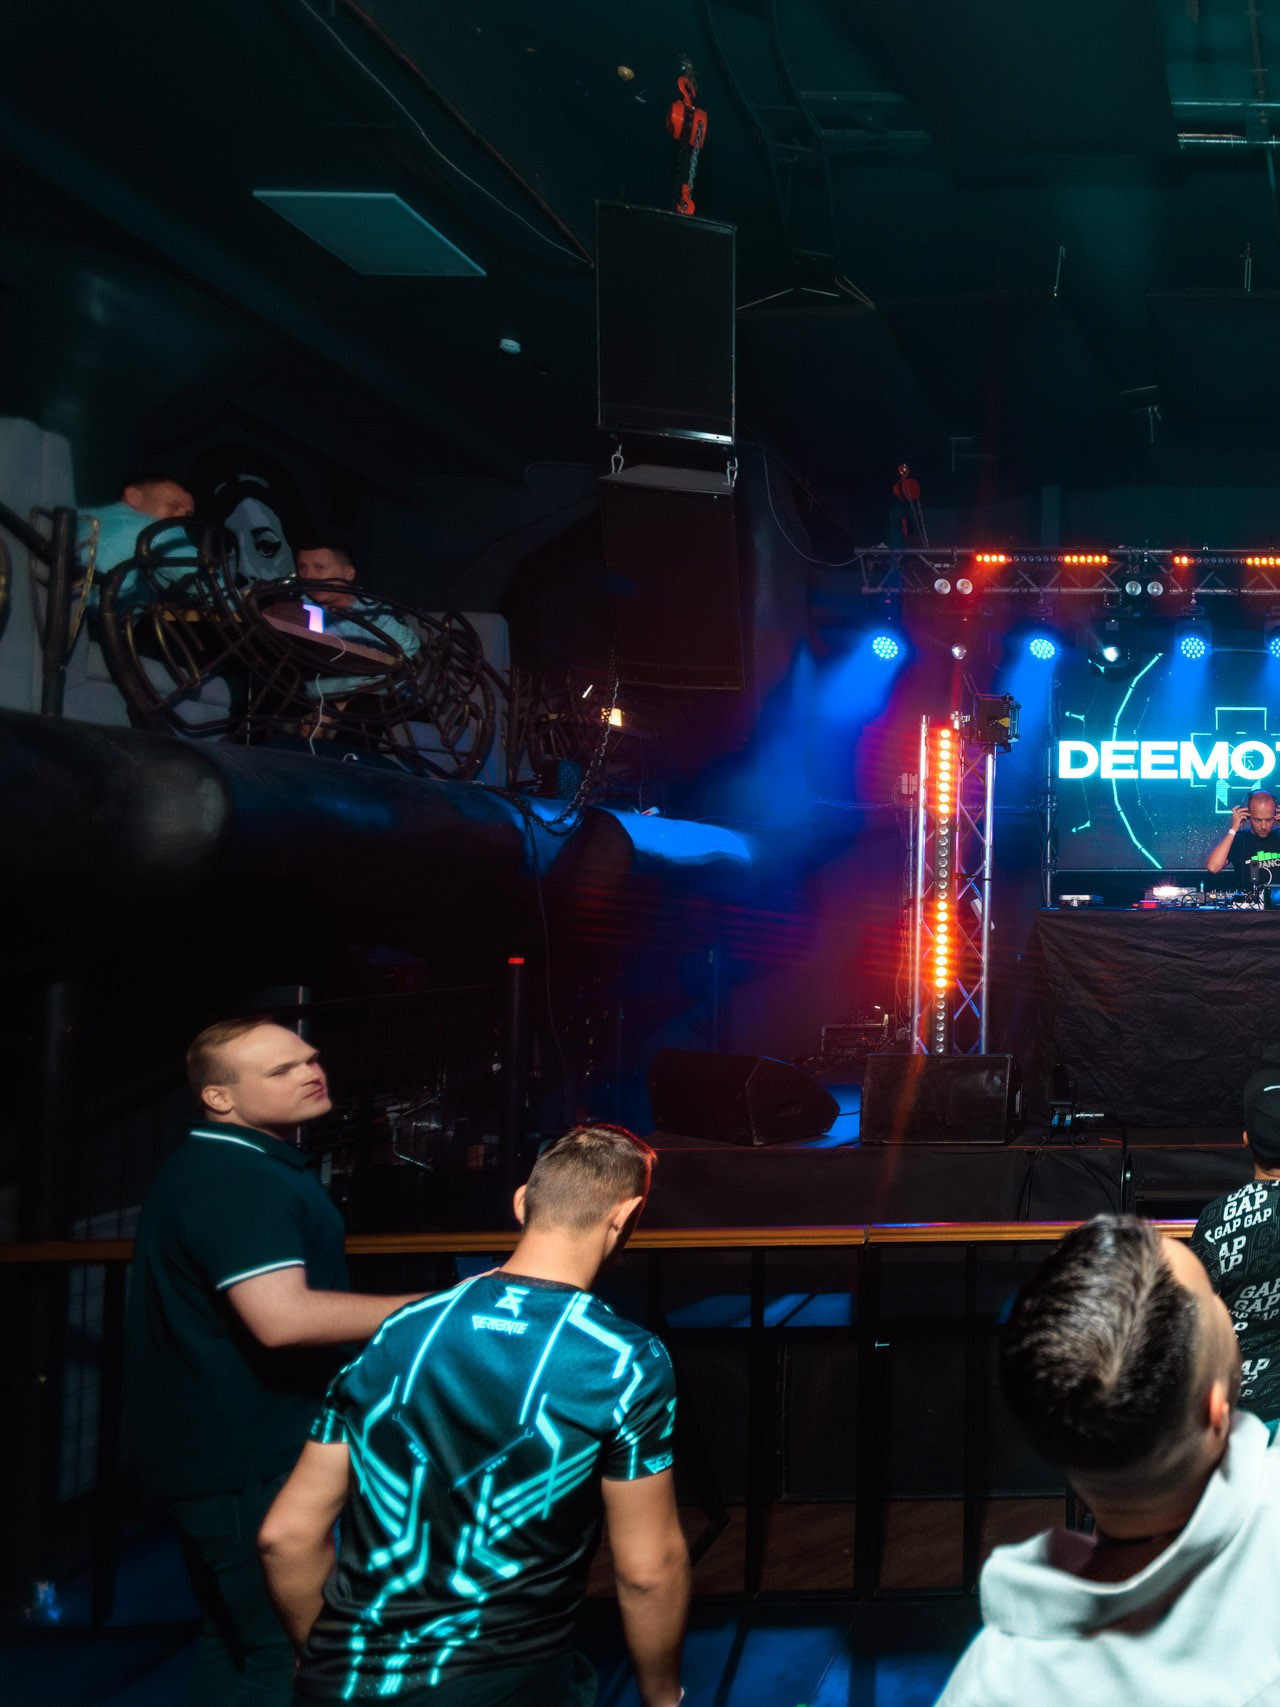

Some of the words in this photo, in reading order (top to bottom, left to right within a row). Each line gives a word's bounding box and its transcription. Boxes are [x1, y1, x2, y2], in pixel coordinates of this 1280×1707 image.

[1223, 1190, 1268, 1221] GAP
[1214, 1218, 1241, 1240] GAP
[1243, 1207, 1272, 1228] GAP
[1234, 1293, 1280, 1313] GAP
